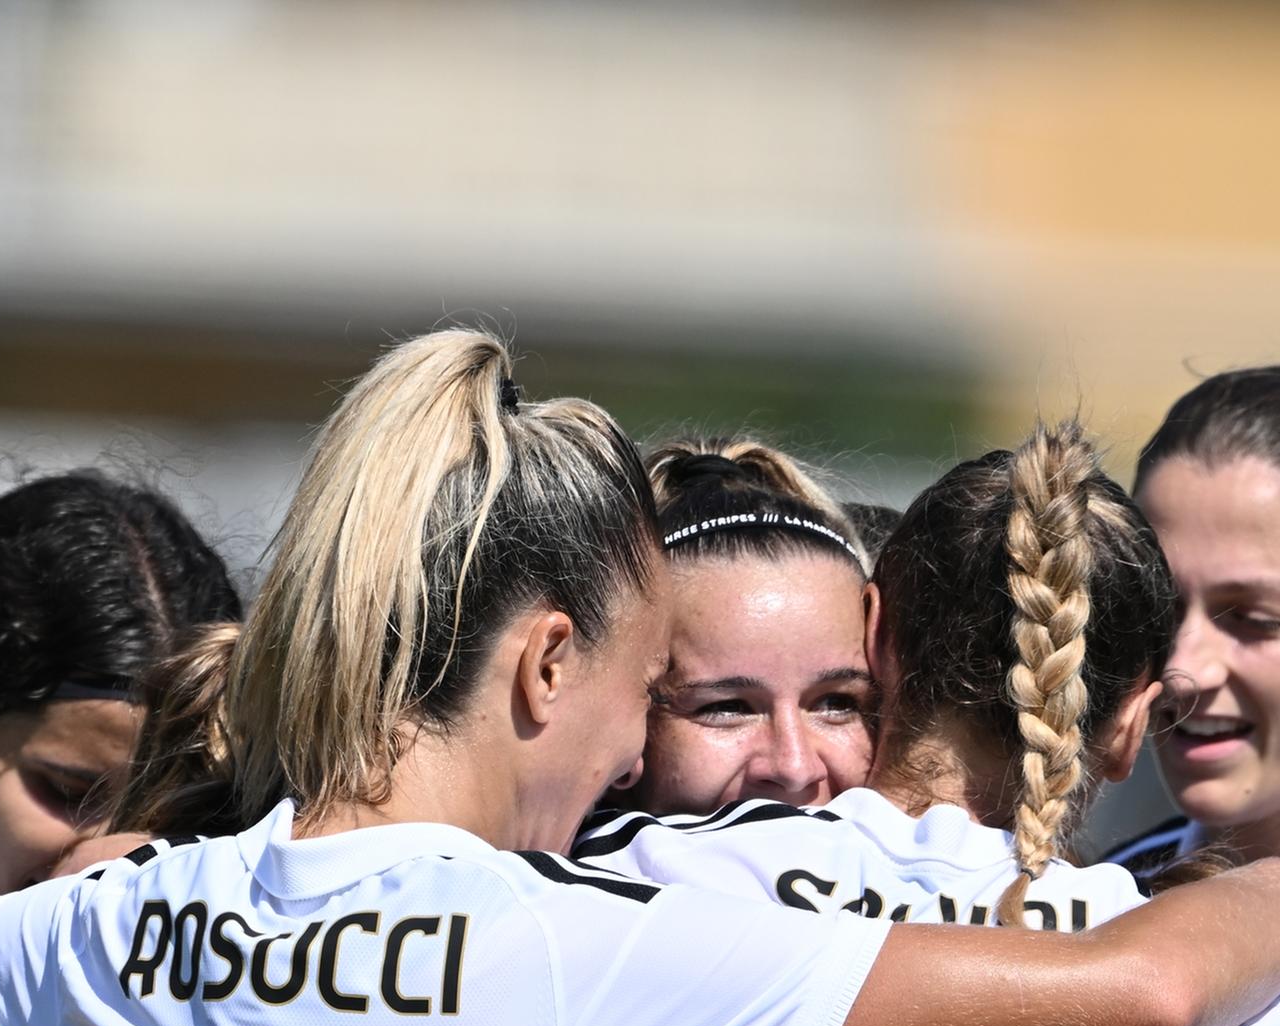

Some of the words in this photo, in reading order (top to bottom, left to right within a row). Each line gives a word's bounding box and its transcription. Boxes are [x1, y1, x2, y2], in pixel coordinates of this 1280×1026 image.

[665, 524, 698, 545] HREE
[701, 513, 756, 531] STRIPES
[120, 899, 470, 1016] ROSUCCI
